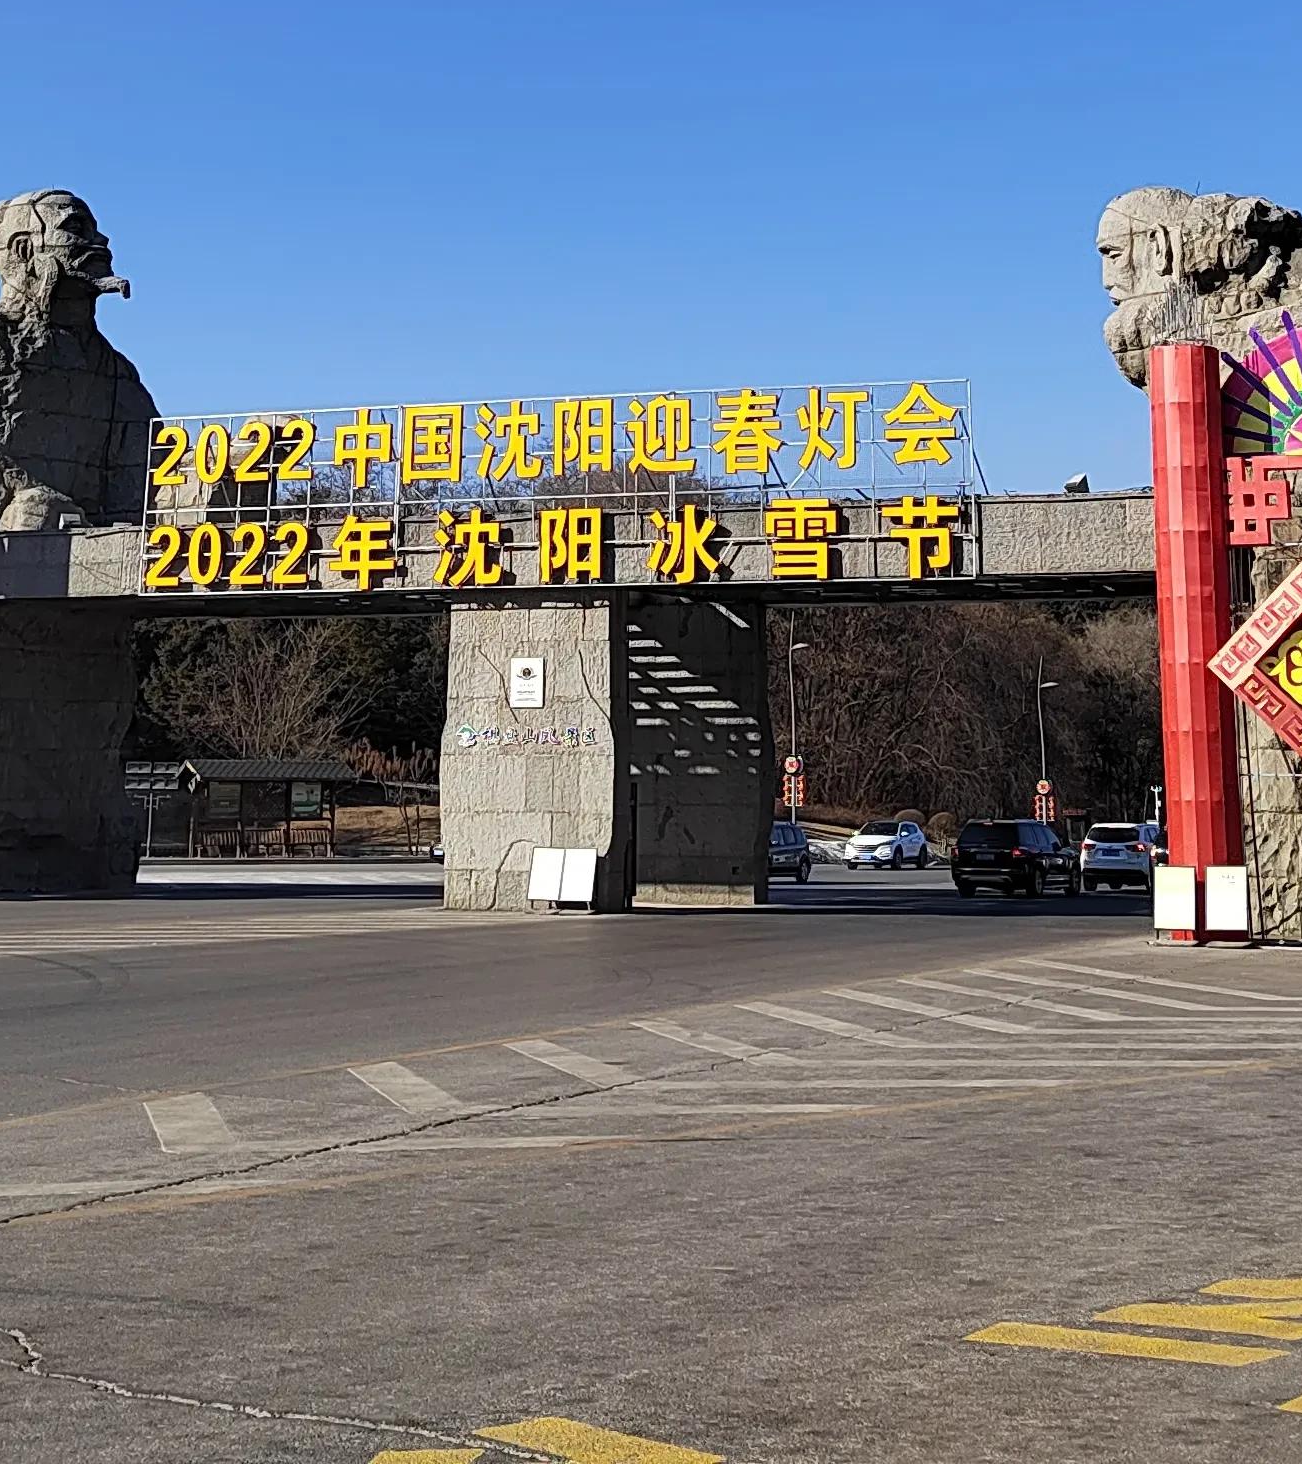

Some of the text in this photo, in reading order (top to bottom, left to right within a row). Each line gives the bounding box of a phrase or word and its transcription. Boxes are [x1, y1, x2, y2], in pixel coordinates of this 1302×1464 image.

[152, 382, 959, 488] 2022中国沈阳迎春灯会
[145, 496, 960, 590] 2022年沈阳冰雪节
